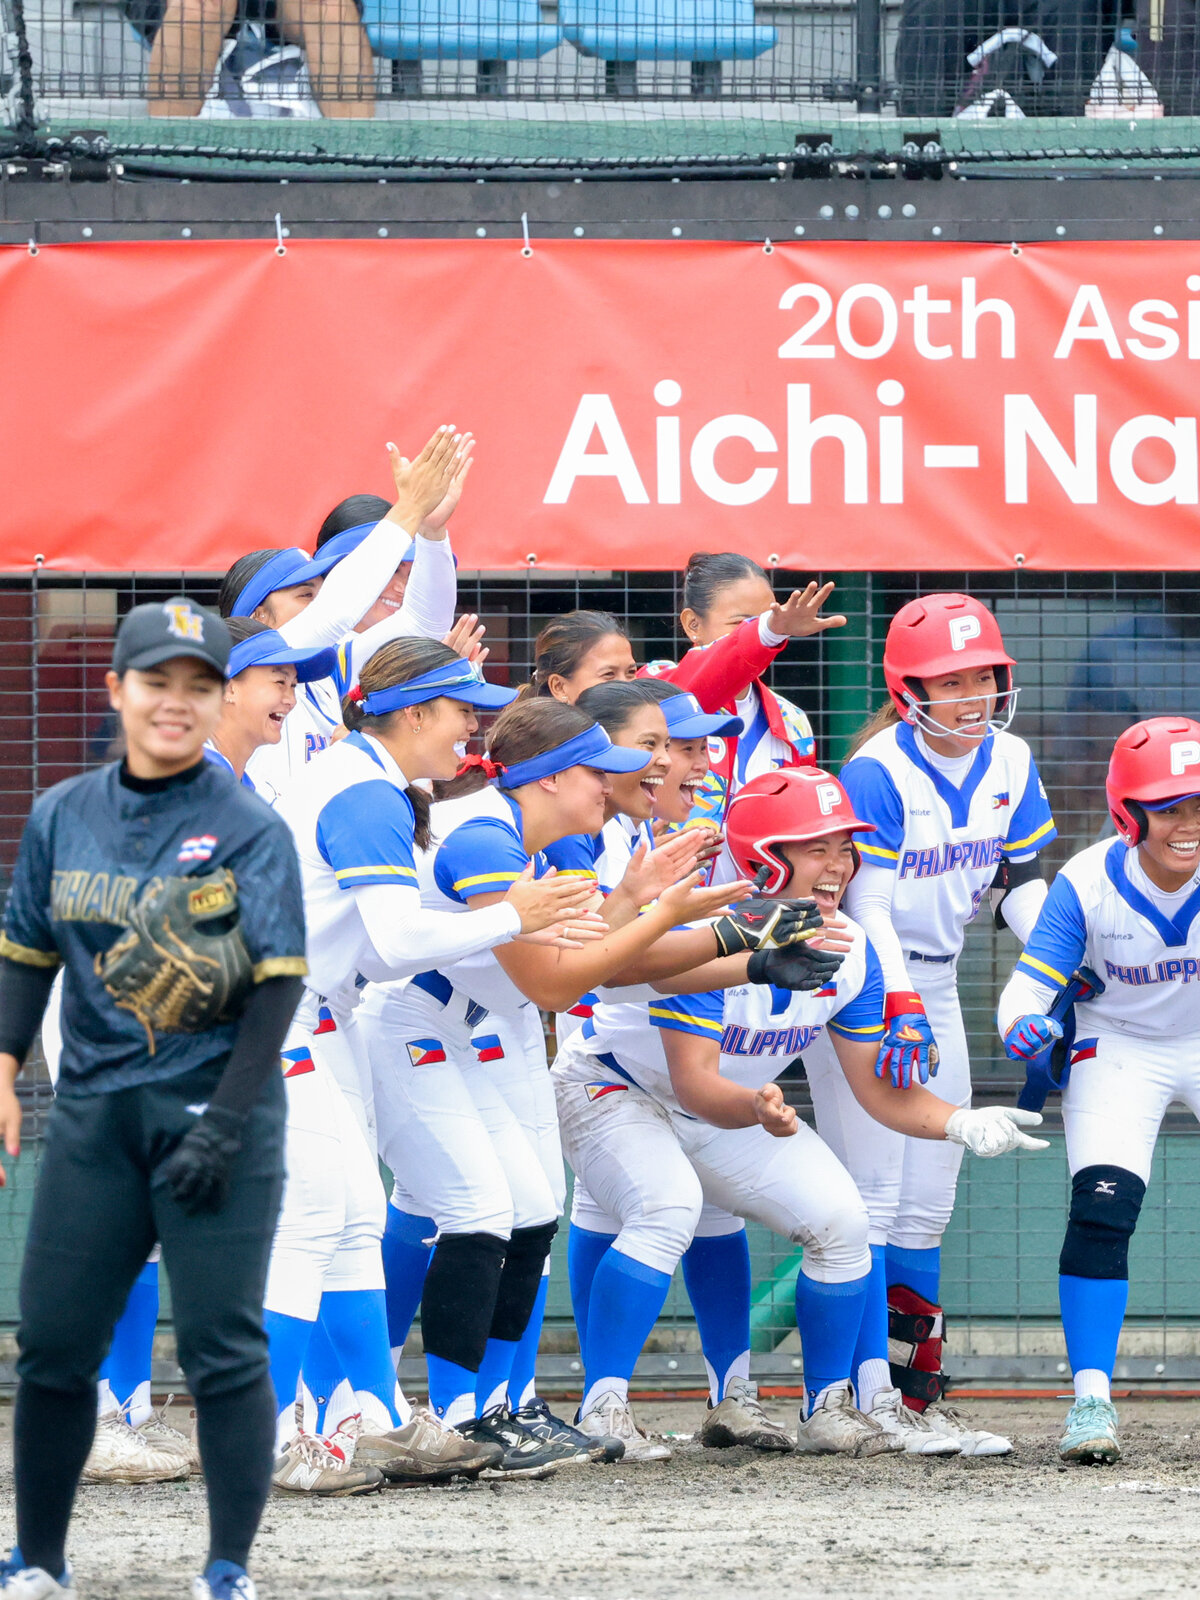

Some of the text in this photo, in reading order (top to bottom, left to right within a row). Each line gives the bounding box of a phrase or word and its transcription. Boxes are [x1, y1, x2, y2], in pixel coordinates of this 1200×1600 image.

[778, 277, 1015, 360] 20th
[949, 615, 981, 650] P
[816, 783, 842, 815] P
[898, 835, 1007, 880] PHIIPPINE
[721, 1023, 824, 1057] ILIPPINE
